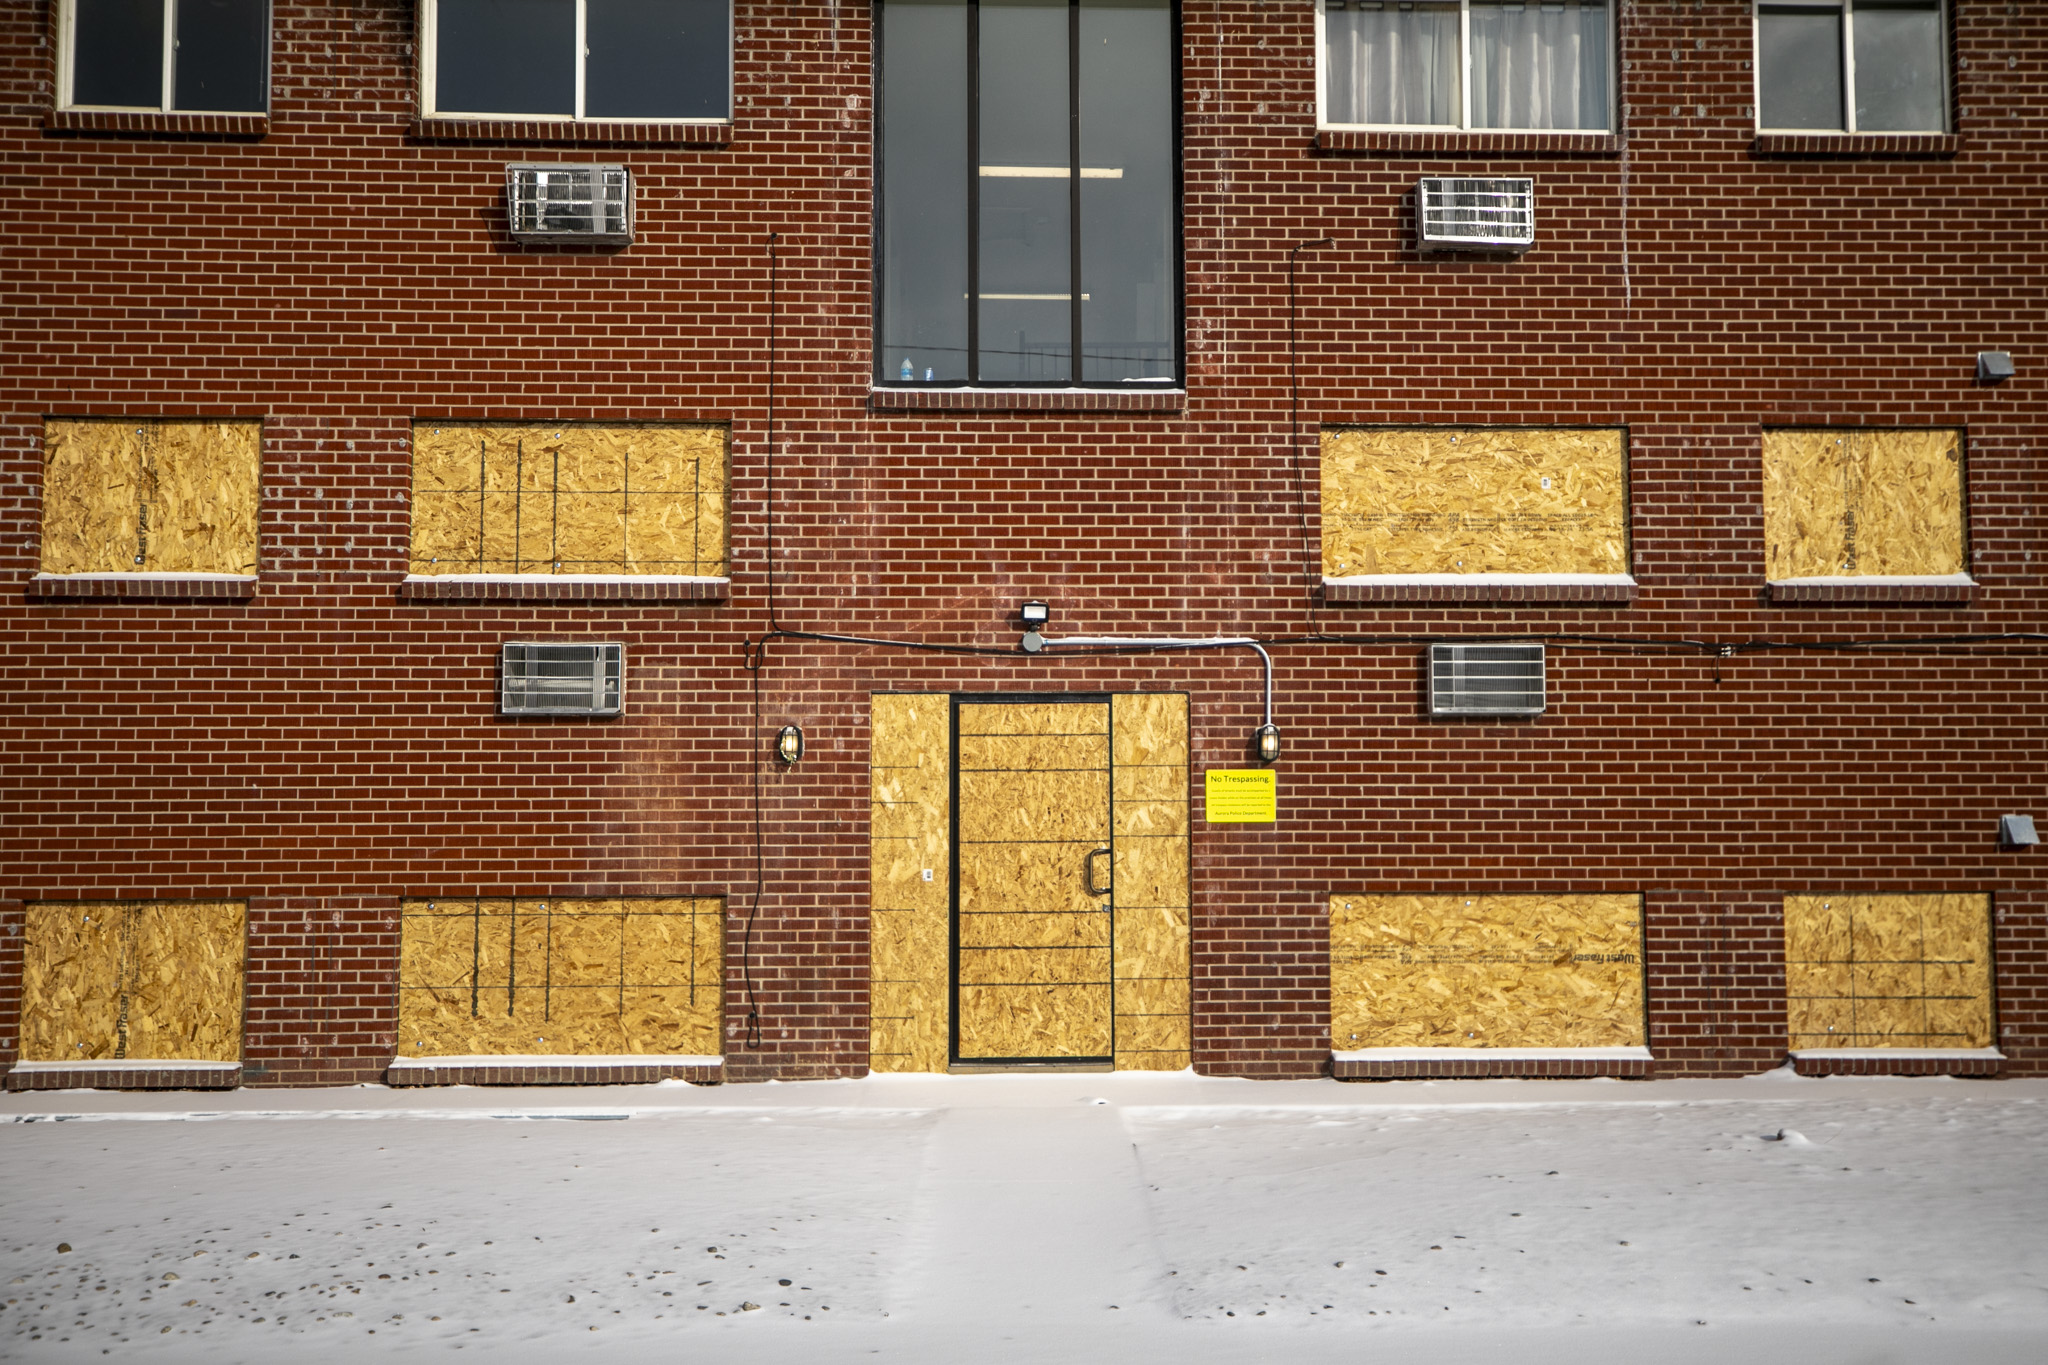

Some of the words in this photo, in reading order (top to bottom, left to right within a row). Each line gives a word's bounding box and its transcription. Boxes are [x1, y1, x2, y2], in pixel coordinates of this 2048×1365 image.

[1210, 775, 1222, 783] No
[1573, 953, 1605, 965] Fraser
[1606, 953, 1635, 964] West
[116, 994, 129, 1029] Fraser
[115, 1029, 127, 1060] West
